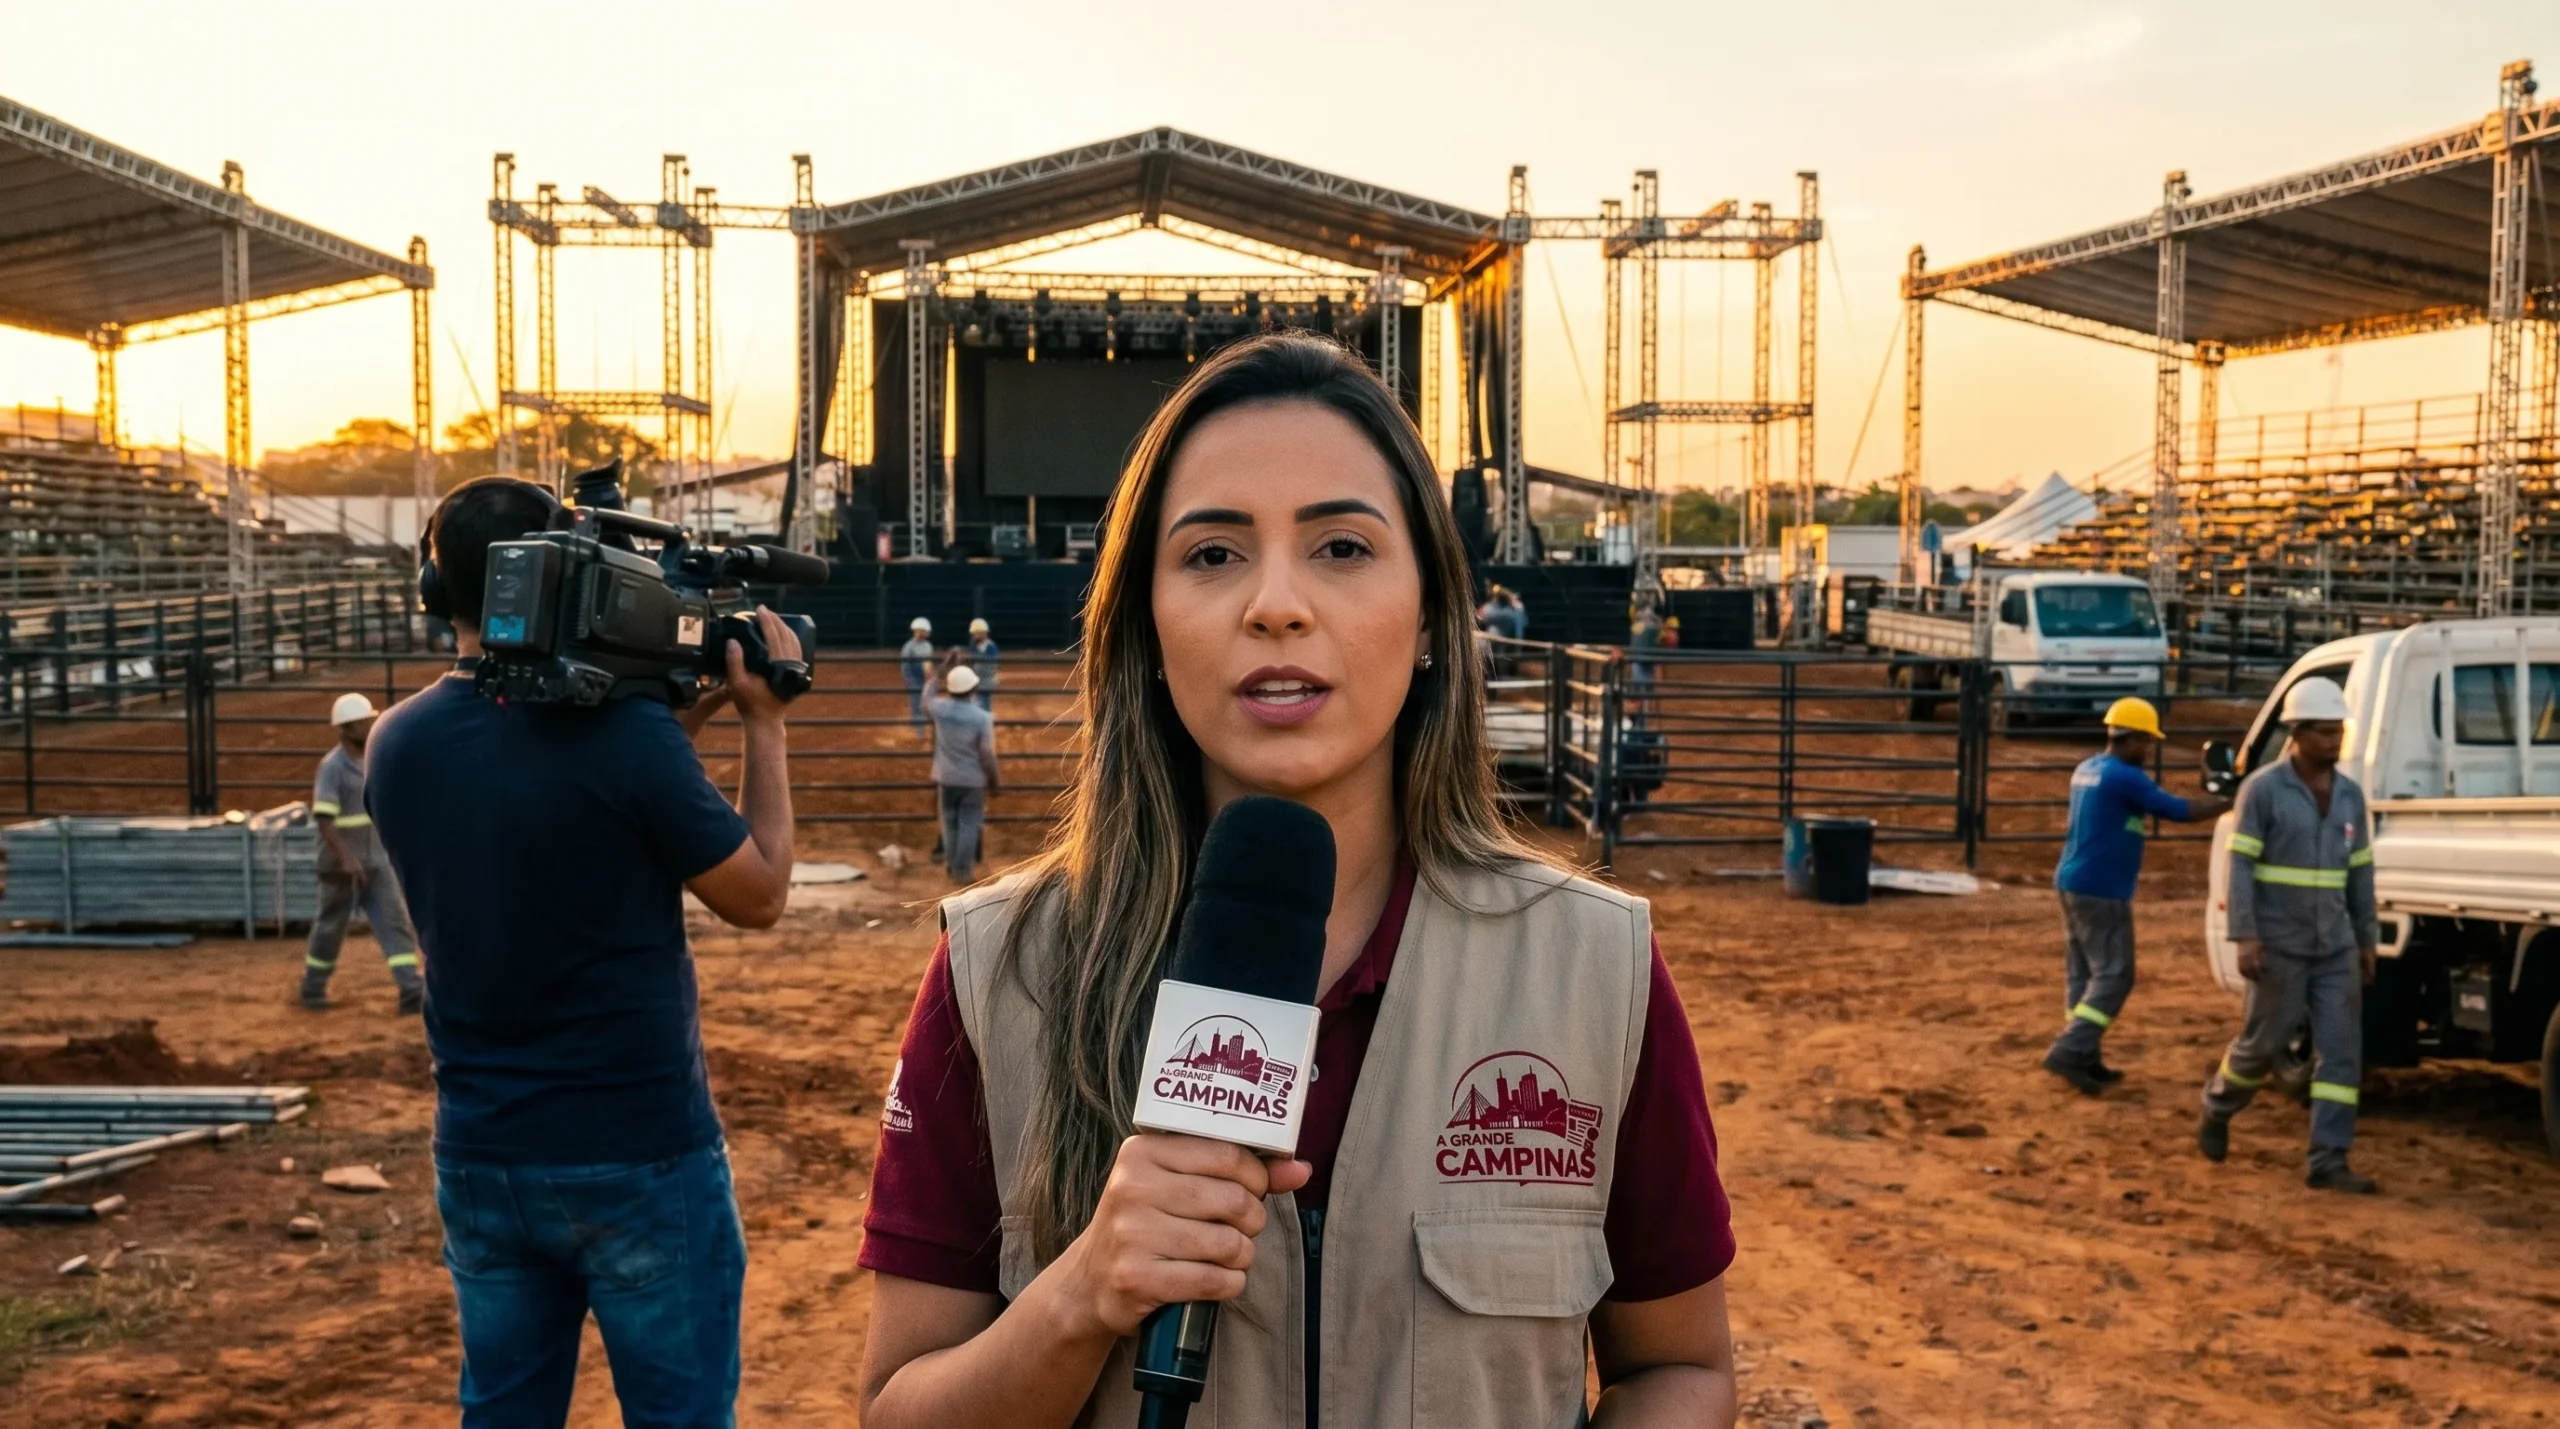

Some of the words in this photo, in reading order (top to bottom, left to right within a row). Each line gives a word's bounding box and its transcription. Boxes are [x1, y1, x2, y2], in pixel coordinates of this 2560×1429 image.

[1153, 1077, 1288, 1119] CAMPINAS
[1436, 1135, 1446, 1147] A
[1450, 1132, 1515, 1147] GRANDE
[1435, 1148, 1596, 1178] CAMPINAS
